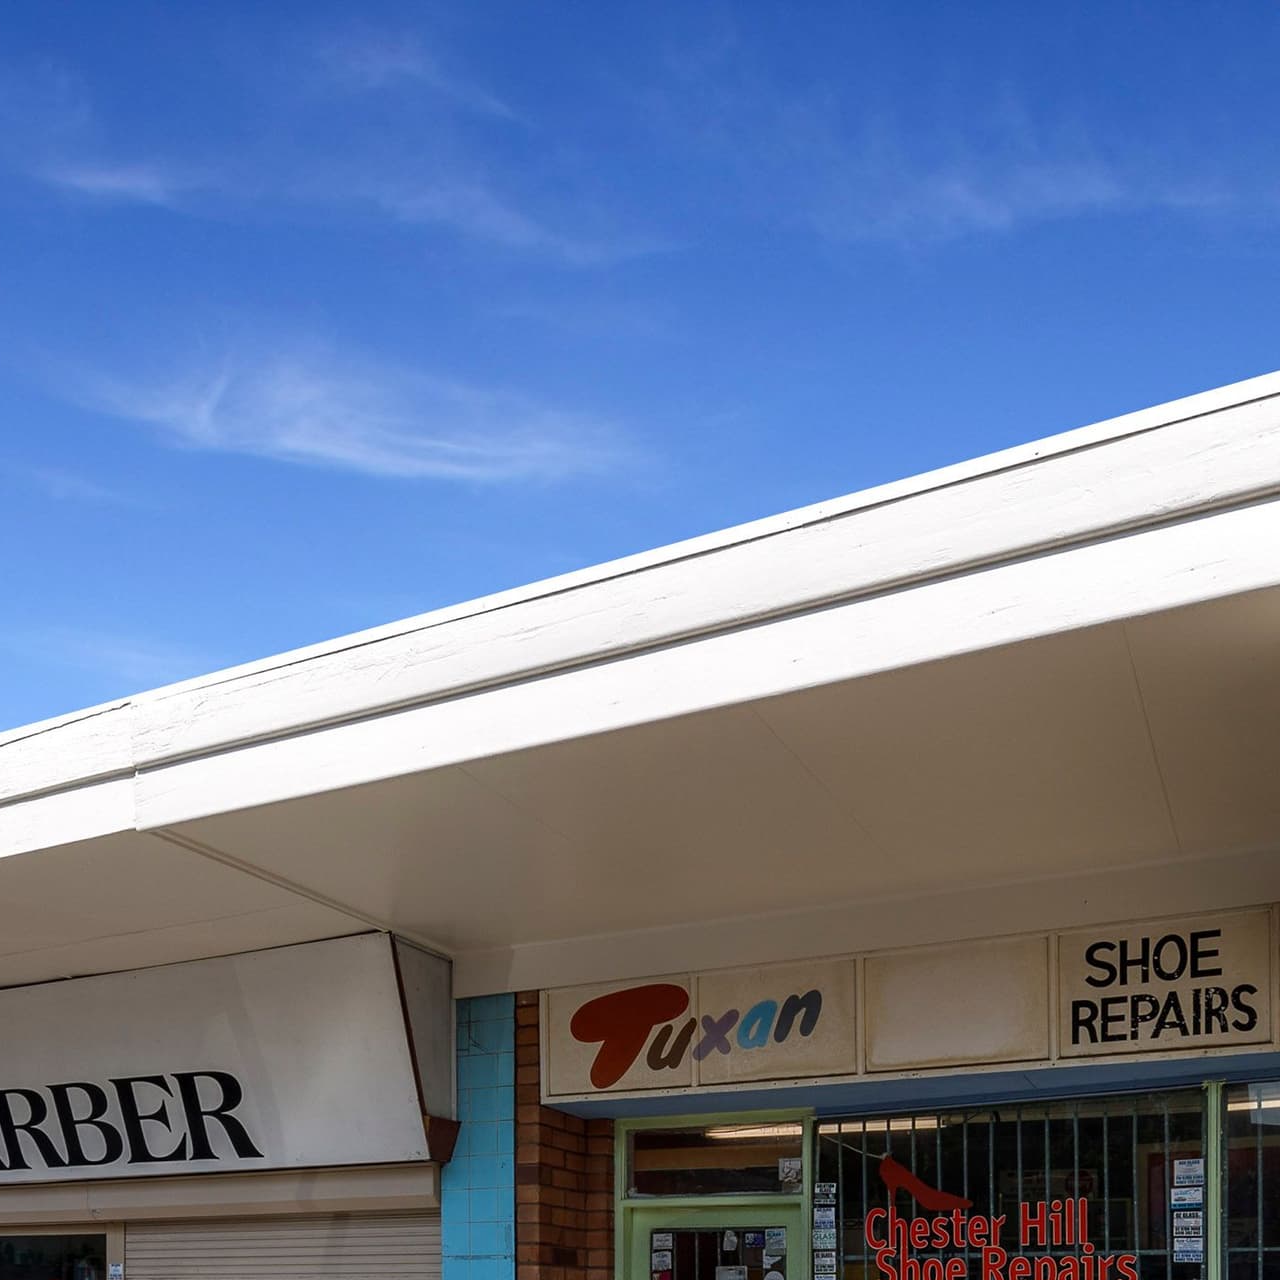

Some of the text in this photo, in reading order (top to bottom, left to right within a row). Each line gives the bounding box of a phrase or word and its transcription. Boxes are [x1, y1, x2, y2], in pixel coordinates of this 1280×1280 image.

[1085, 928, 1223, 988] SHOE
[570, 983, 823, 1089] Tuxan
[1072, 984, 1258, 1045] REPAIRS
[865, 1207, 1006, 1249] Chester
[1020, 1197, 1089, 1246] Hill
